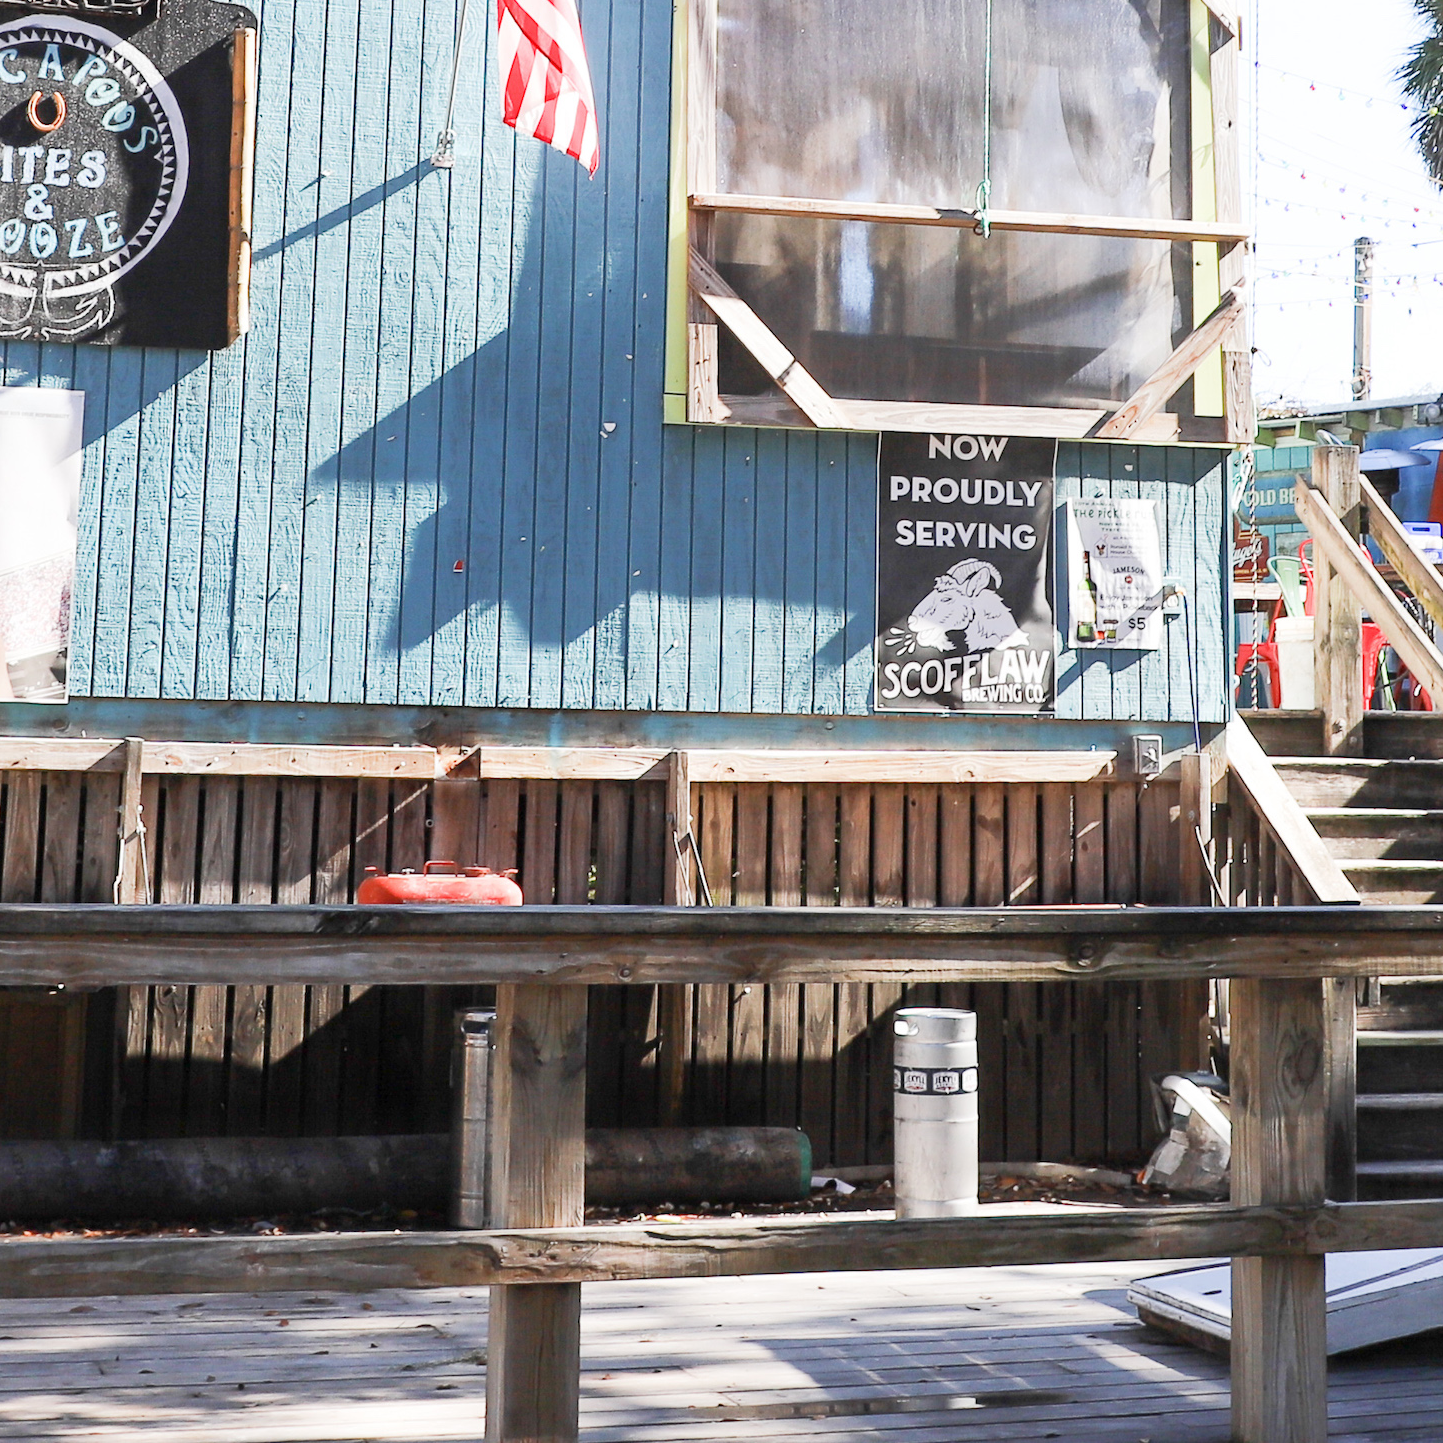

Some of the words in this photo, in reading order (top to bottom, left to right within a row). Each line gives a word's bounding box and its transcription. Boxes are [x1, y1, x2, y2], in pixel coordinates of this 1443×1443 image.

[22, 183, 55, 221] &
[928, 433, 1009, 462] NOW
[889, 475, 1043, 507] PROUDLY
[1243, 489, 1277, 508] COLD
[895, 519, 1037, 551] SERVING
[1112, 566, 1145, 575] JAMESON
[1128, 617, 1146, 630] $5
[881, 649, 1051, 700] SCOFFLAW
[961, 683, 1024, 704] BREWING
